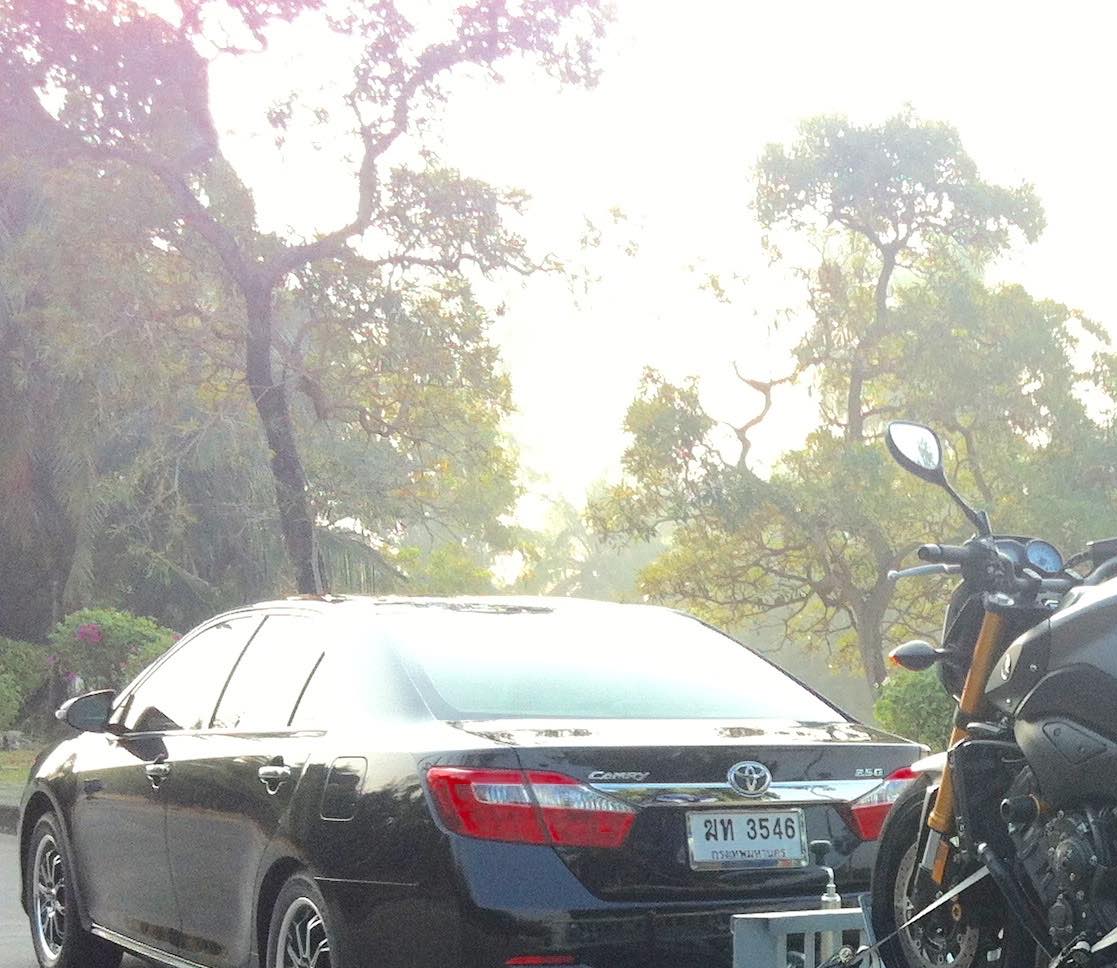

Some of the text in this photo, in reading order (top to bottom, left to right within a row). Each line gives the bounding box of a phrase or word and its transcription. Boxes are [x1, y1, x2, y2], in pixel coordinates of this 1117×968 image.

[746, 817, 796, 840] 3546
[711, 848, 786, 860] กรงเทพมหานคร
